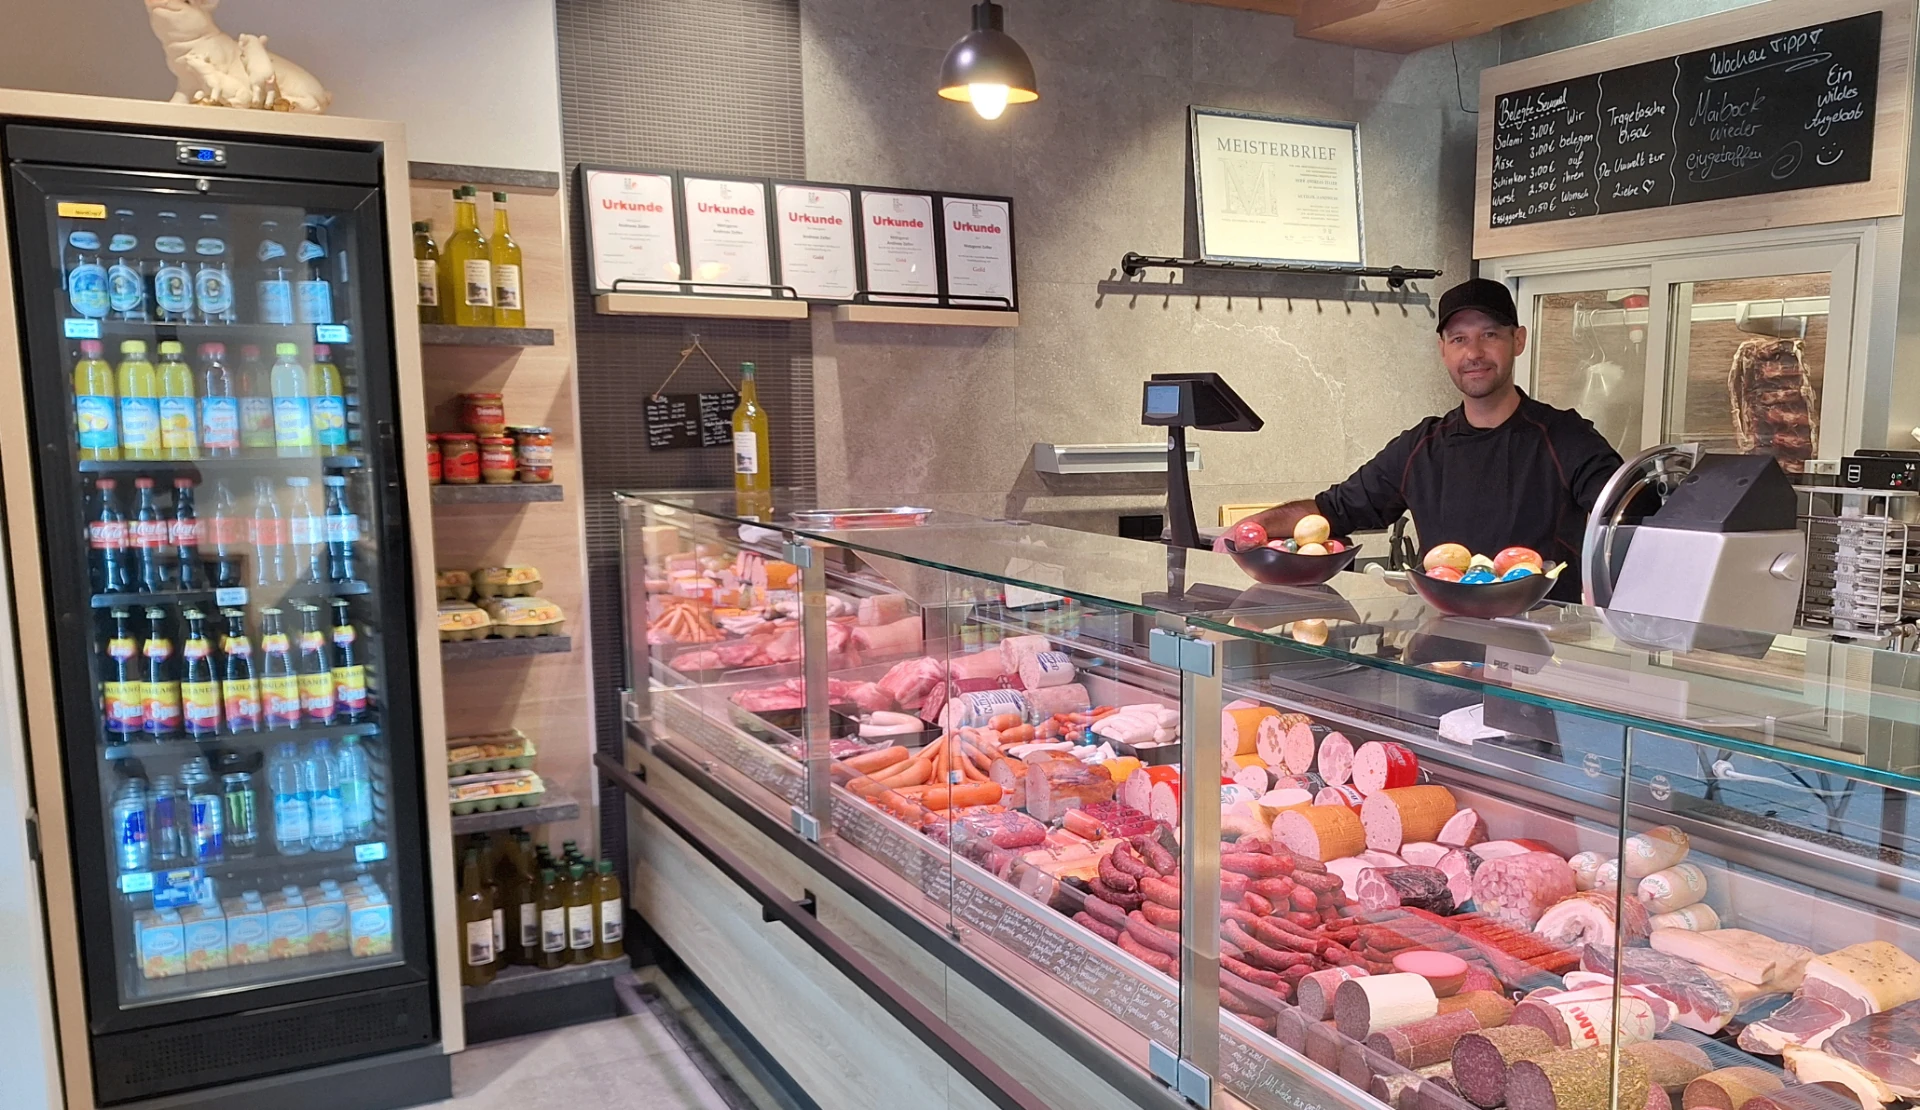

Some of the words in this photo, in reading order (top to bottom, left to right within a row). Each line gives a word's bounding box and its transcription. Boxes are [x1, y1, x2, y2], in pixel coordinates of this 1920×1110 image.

[1710, 48, 1767, 75] Wochen
[1826, 63, 1853, 86] Ein
[1498, 96, 1535, 130] Belegte
[1566, 108, 1586, 126] Wir
[1607, 101, 1666, 127] Tragetasche
[1689, 87, 1766, 127] Maibock
[1710, 118, 1763, 141] wieder
[1804, 102, 1864, 137] Angebot
[1216, 137, 1338, 161] MEISTERBRIEF
[1494, 133, 1523, 151] Salami
[1559, 131, 1594, 154] belegen
[1567, 150, 1585, 170] auf
[1614, 151, 1646, 174] Umwelt
[1648, 152, 1666, 165] zur
[1686, 145, 1763, 180] eingetroffen
[1492, 171, 1527, 191] Schinken
[1562, 170, 1585, 184] ihren
[1492, 188, 1516, 207] Wurst
[1560, 188, 1590, 203] Wunsch
[1612, 182, 1639, 199] Liebe
[602, 198, 665, 213] Urkunde
[697, 202, 756, 216] Urkunde
[788, 211, 844, 226] Urkunde
[872, 215, 925, 229] Urkunde
[952, 220, 1002, 235] Urkunde
[1569, 1006, 1601, 1047] LAMI
